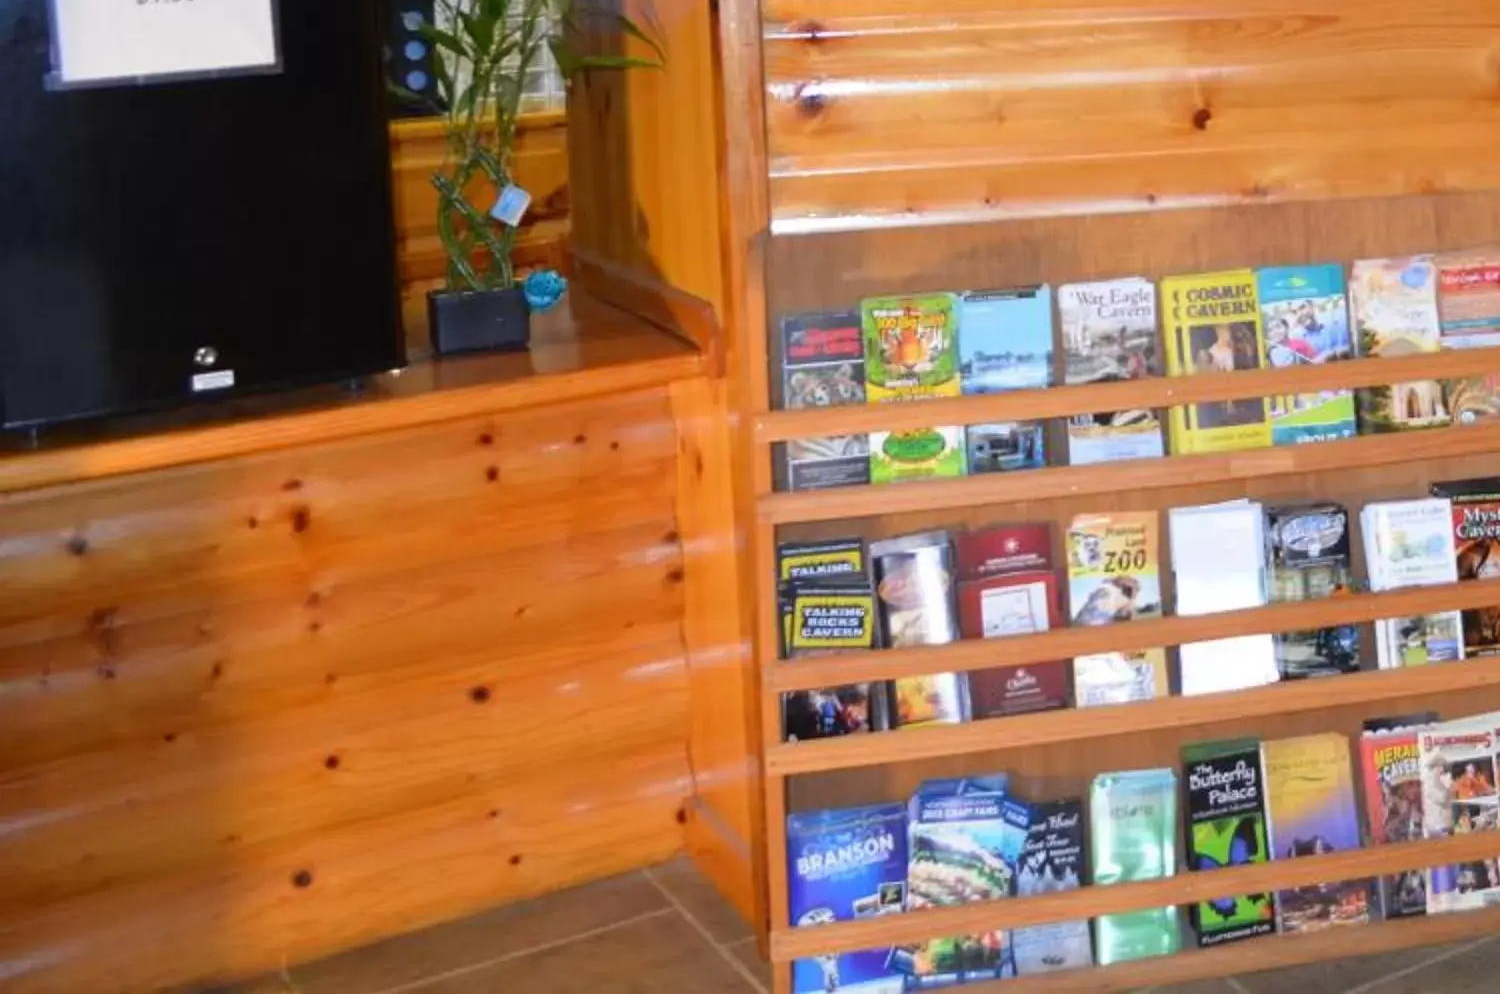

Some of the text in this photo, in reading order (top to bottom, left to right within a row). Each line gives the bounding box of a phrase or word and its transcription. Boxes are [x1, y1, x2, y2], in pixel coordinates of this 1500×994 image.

[1074, 286, 1152, 307] War Eagle
[1186, 284, 1253, 302] COSMIC
[1096, 305, 1152, 319] Cavern
[1186, 300, 1256, 318] CAVERN
[792, 562, 853, 577] TALKING
[1104, 549, 1147, 573] ZOO
[803, 607, 865, 617] TALKING
[807, 617, 859, 627] ROCKS
[802, 628, 863, 638] CAVERN
[1190, 760, 1256, 790] Butterfly
[1195, 763, 1213, 775] The
[1208, 784, 1257, 805] Palace
[797, 834, 893, 875] BRANSON
